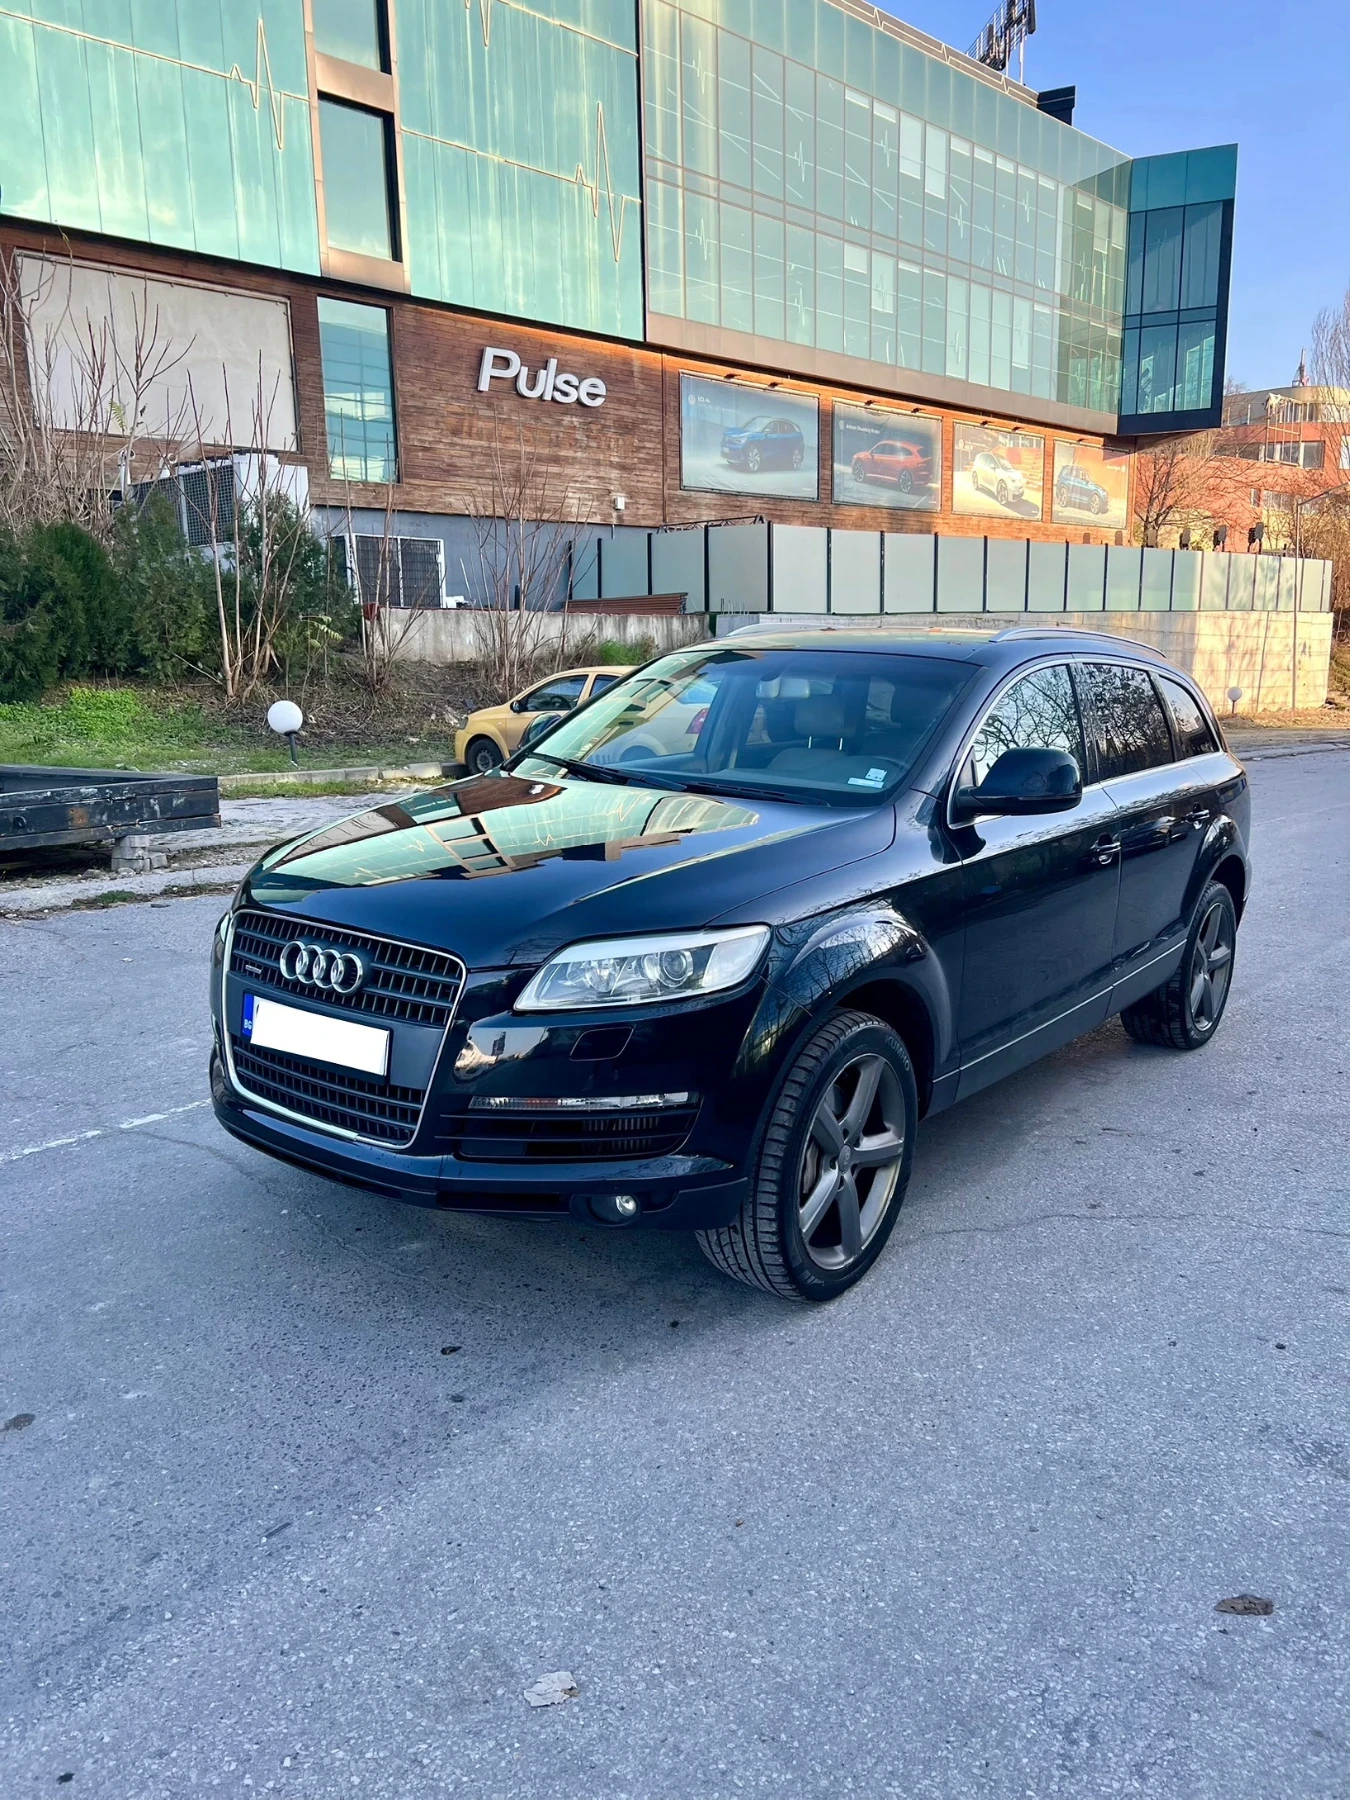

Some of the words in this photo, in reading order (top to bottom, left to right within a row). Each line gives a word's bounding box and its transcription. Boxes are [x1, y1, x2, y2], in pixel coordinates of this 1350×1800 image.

[477, 346, 607, 407] Pulse
[244, 1019, 252, 1030] BG
[885, 1035, 909, 1071] KUMHO
